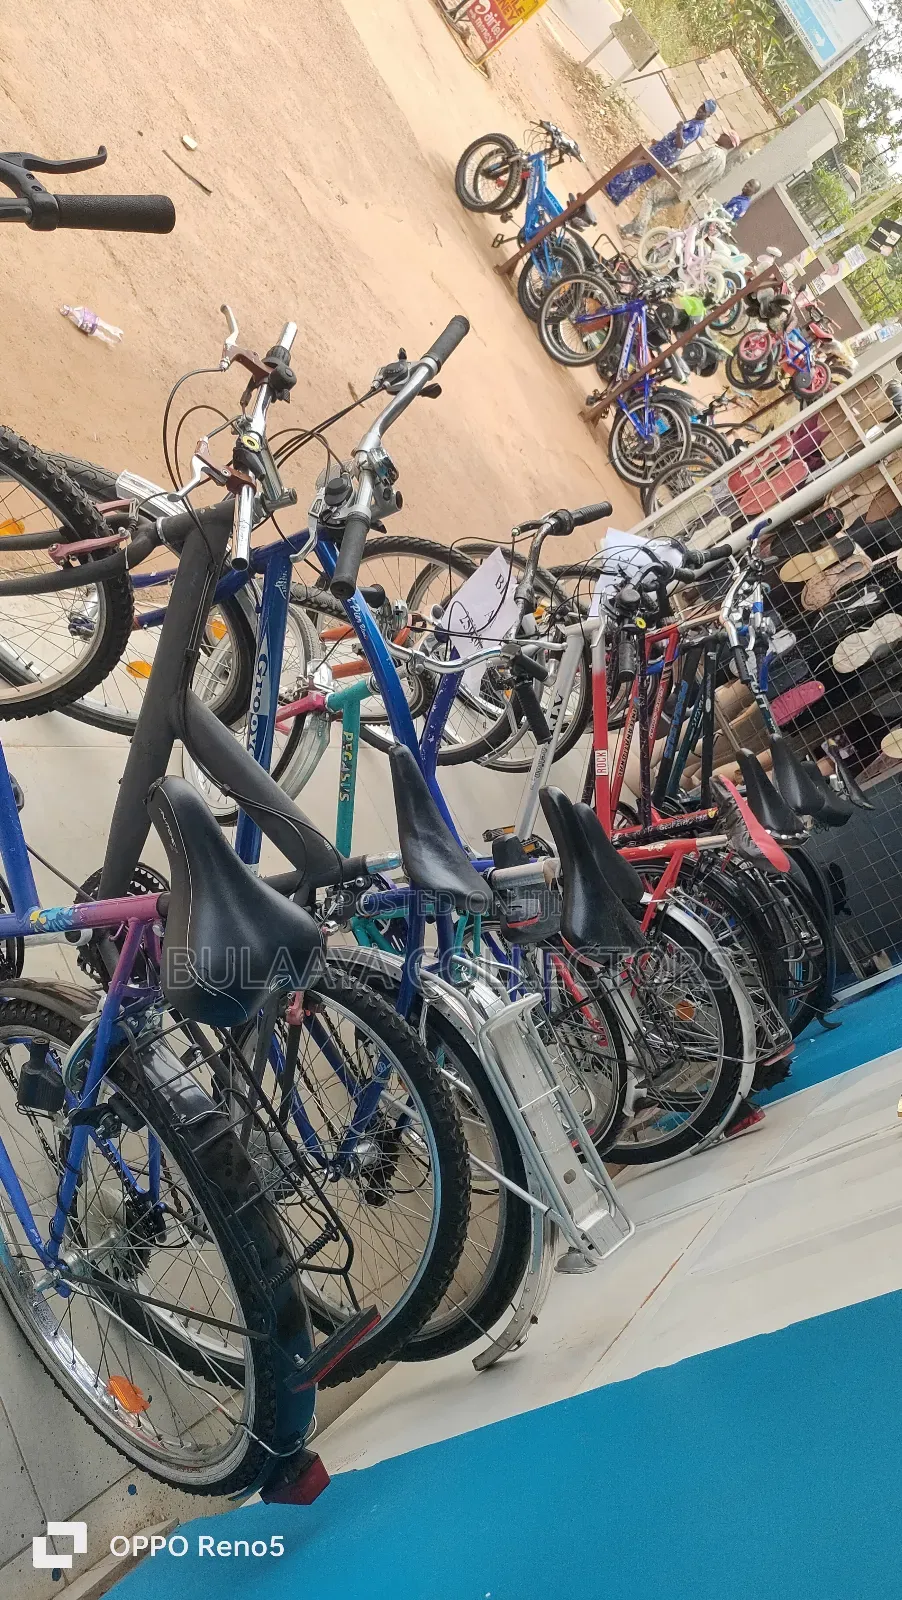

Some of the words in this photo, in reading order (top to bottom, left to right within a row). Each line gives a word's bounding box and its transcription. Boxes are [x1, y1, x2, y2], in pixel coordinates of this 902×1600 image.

[474, 17, 495, 45] money
[483, 11, 506, 40] airtel
[339, 731, 354, 802] PEGASUS
[596, 751, 607, 774] ROCK
